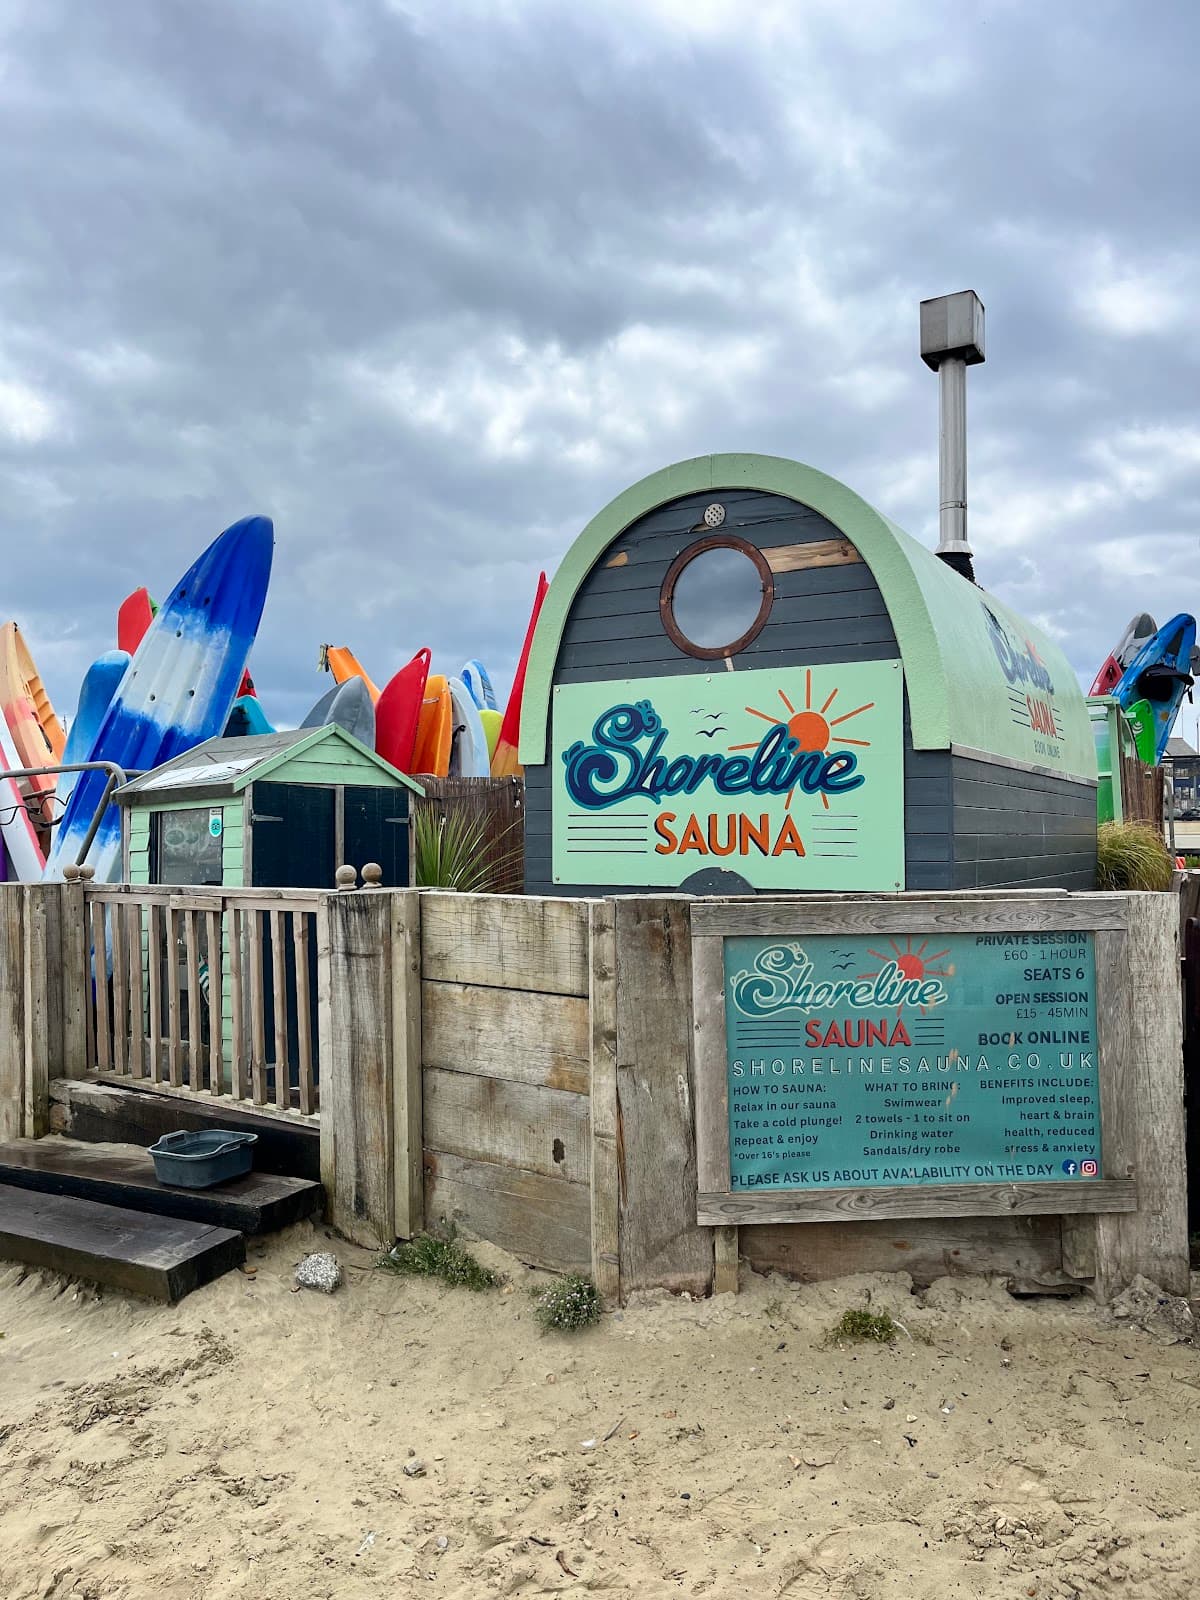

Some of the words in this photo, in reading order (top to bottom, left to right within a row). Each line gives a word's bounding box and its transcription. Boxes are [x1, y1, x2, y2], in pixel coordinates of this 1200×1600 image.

[561, 699, 865, 810] Shoreline
[653, 812, 805, 858] SAUNA
[976, 934, 1029, 946] PRIVATE
[1031, 933, 1087, 945] SESSION
[1004, 949, 1028, 961] £60
[1040, 950, 1047, 960] 1
[1050, 948, 1086, 960] HOUR
[730, 942, 948, 1018] Shoreline
[1023, 967, 1071, 981] SEATS
[1075, 967, 1085, 980] 6
[995, 993, 1030, 1005] OPEN
[1033, 992, 1088, 1003] SESSION
[1016, 1008, 1037, 1019] £15
[1048, 1007, 1088, 1018] 45MIN
[804, 1018, 913, 1048] SAUNA
[978, 1031, 1022, 1045] BOOK
[1028, 1030, 1090, 1044] ONLINE
[732, 1052, 1094, 1077] SHORELINESAUNA.CO.UK
[733, 1086, 760, 1096] HOW
[763, 1084, 779, 1094] TO
[782, 1083, 827, 1094] SAUNA:
[864, 1083, 899, 1092] WHAT
[903, 1082, 918, 1091] TO
[980, 1078, 1034, 1089] BENEFITS
[1038, 1078, 1094, 1087] INCLUDE:
[734, 1102, 763, 1112] Relax
[767, 1102, 777, 1111] in
[780, 1102, 799, 1110] our
[802, 1101, 836, 1109] sauna
[884, 1098, 942, 1107] Swimwear
[1002, 1095, 1055, 1106] Improved
[1059, 1095, 1094, 1105] sleep,
[855, 1114, 862, 1123] 2
[865, 1114, 903, 1123] towels
[914, 1114, 920, 1122] 1
[924, 1114, 935, 1123] to
[938, 1113, 952, 1122] sit
[956, 1114, 970, 1122] on
[1020, 1111, 1049, 1120] heart
[1053, 1111, 1061, 1120] &
[1064, 1110, 1095, 1120] brain
[734, 1119, 759, 1129] Take
[762, 1120, 769, 1128] a
[772, 1116, 797, 1127] cold
[800, 1115, 842, 1129] plunge!
[870, 1130, 917, 1140] Drinking
[921, 1130, 954, 1138] water
[1004, 1127, 1044, 1138] health,
[1047, 1127, 1095, 1136] reduced
[734, 1136, 774, 1148] Repeat
[776, 1134, 785, 1144] &
[788, 1134, 818, 1145] enjoy
[762, 1151, 780, 1159] 16's
[782, 1150, 811, 1160] please
[863, 1145, 931, 1156] Sandals/dry
[934, 1144, 961, 1153] robe
[1004, 1143, 1039, 1153] stress
[1042, 1144, 1049, 1153] &
[1053, 1143, 1095, 1155] anxiety
[731, 1173, 780, 1186] PLEASE
[783, 1172, 809, 1183] ASK
[812, 1171, 830, 1182] US
[833, 1169, 878, 1181] ABOUT
[974, 1165, 994, 1177] ON
[997, 1165, 1025, 1176] THE
[1027, 1164, 1054, 1176] DAY
